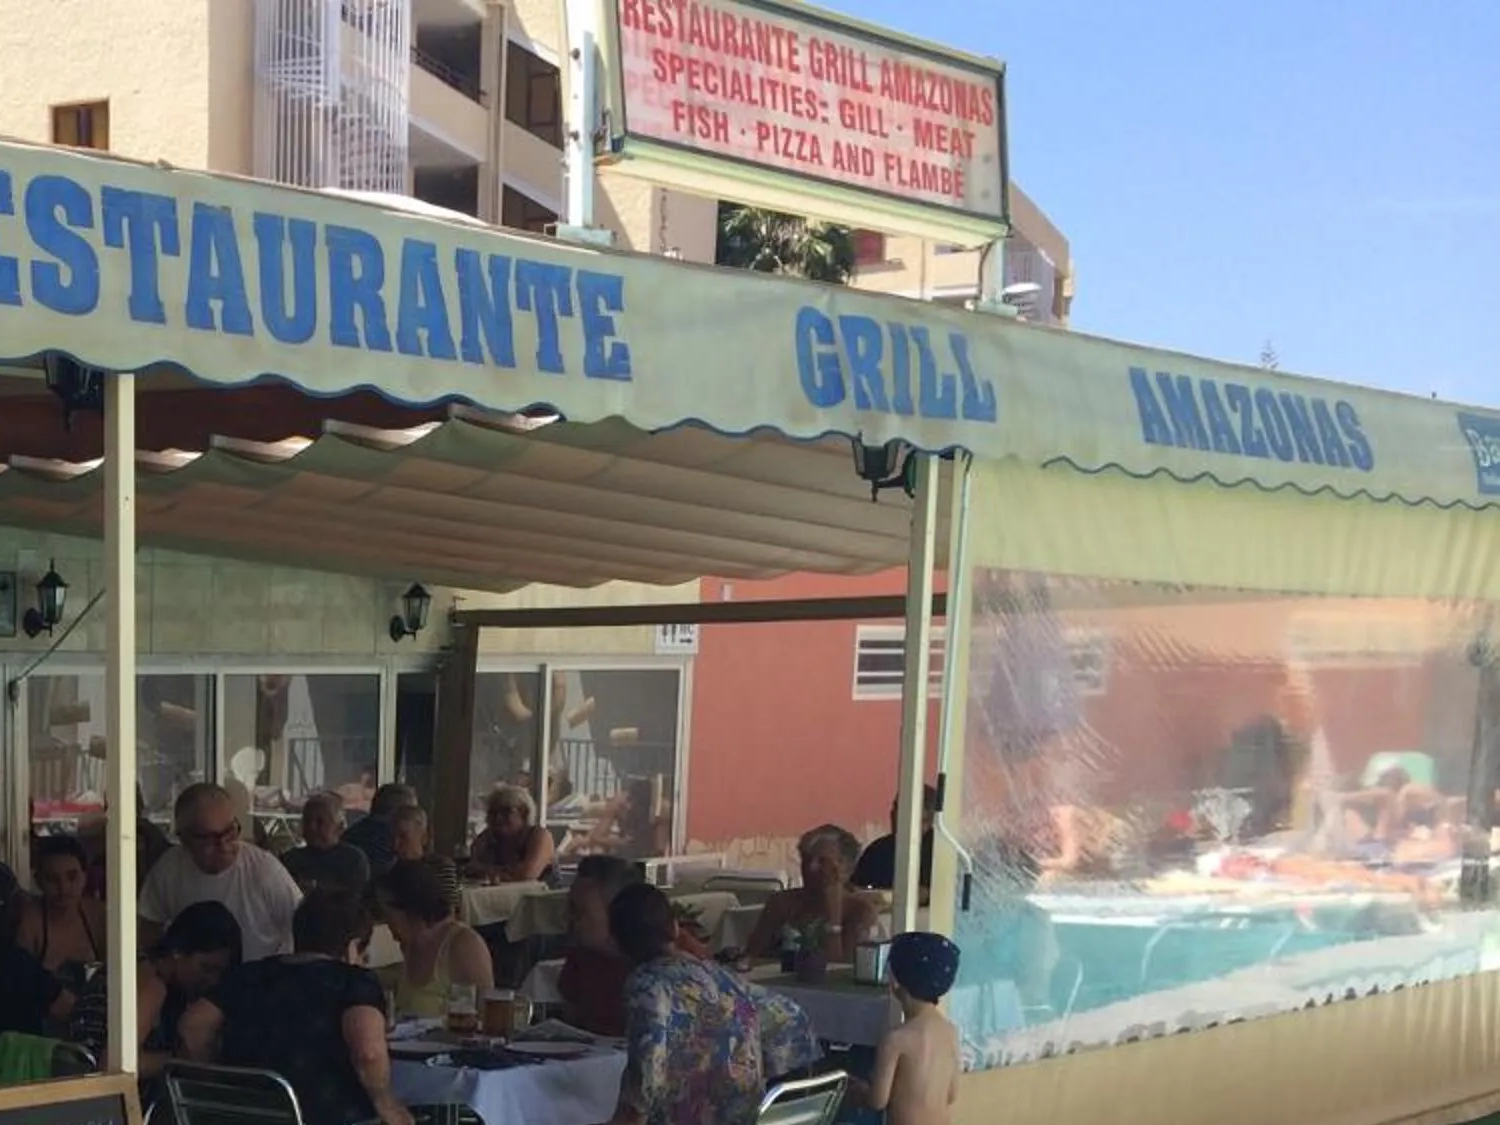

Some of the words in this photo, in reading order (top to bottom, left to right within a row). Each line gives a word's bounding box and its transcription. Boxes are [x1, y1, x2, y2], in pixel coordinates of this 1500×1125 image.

[622, 0, 800, 73] RESTAURANTE
[808, 37, 873, 95] GRILL
[879, 58, 994, 127] AMAZONAS
[672, 100, 729, 144] FISH
[757, 121, 825, 166] PIZZA
[832, 141, 875, 178] AND
[838, 99, 889, 140] GILL
[913, 118, 975, 159] MEAT
[795, 305, 997, 423] GRILL
[1128, 367, 1375, 472] AMAZONAS
